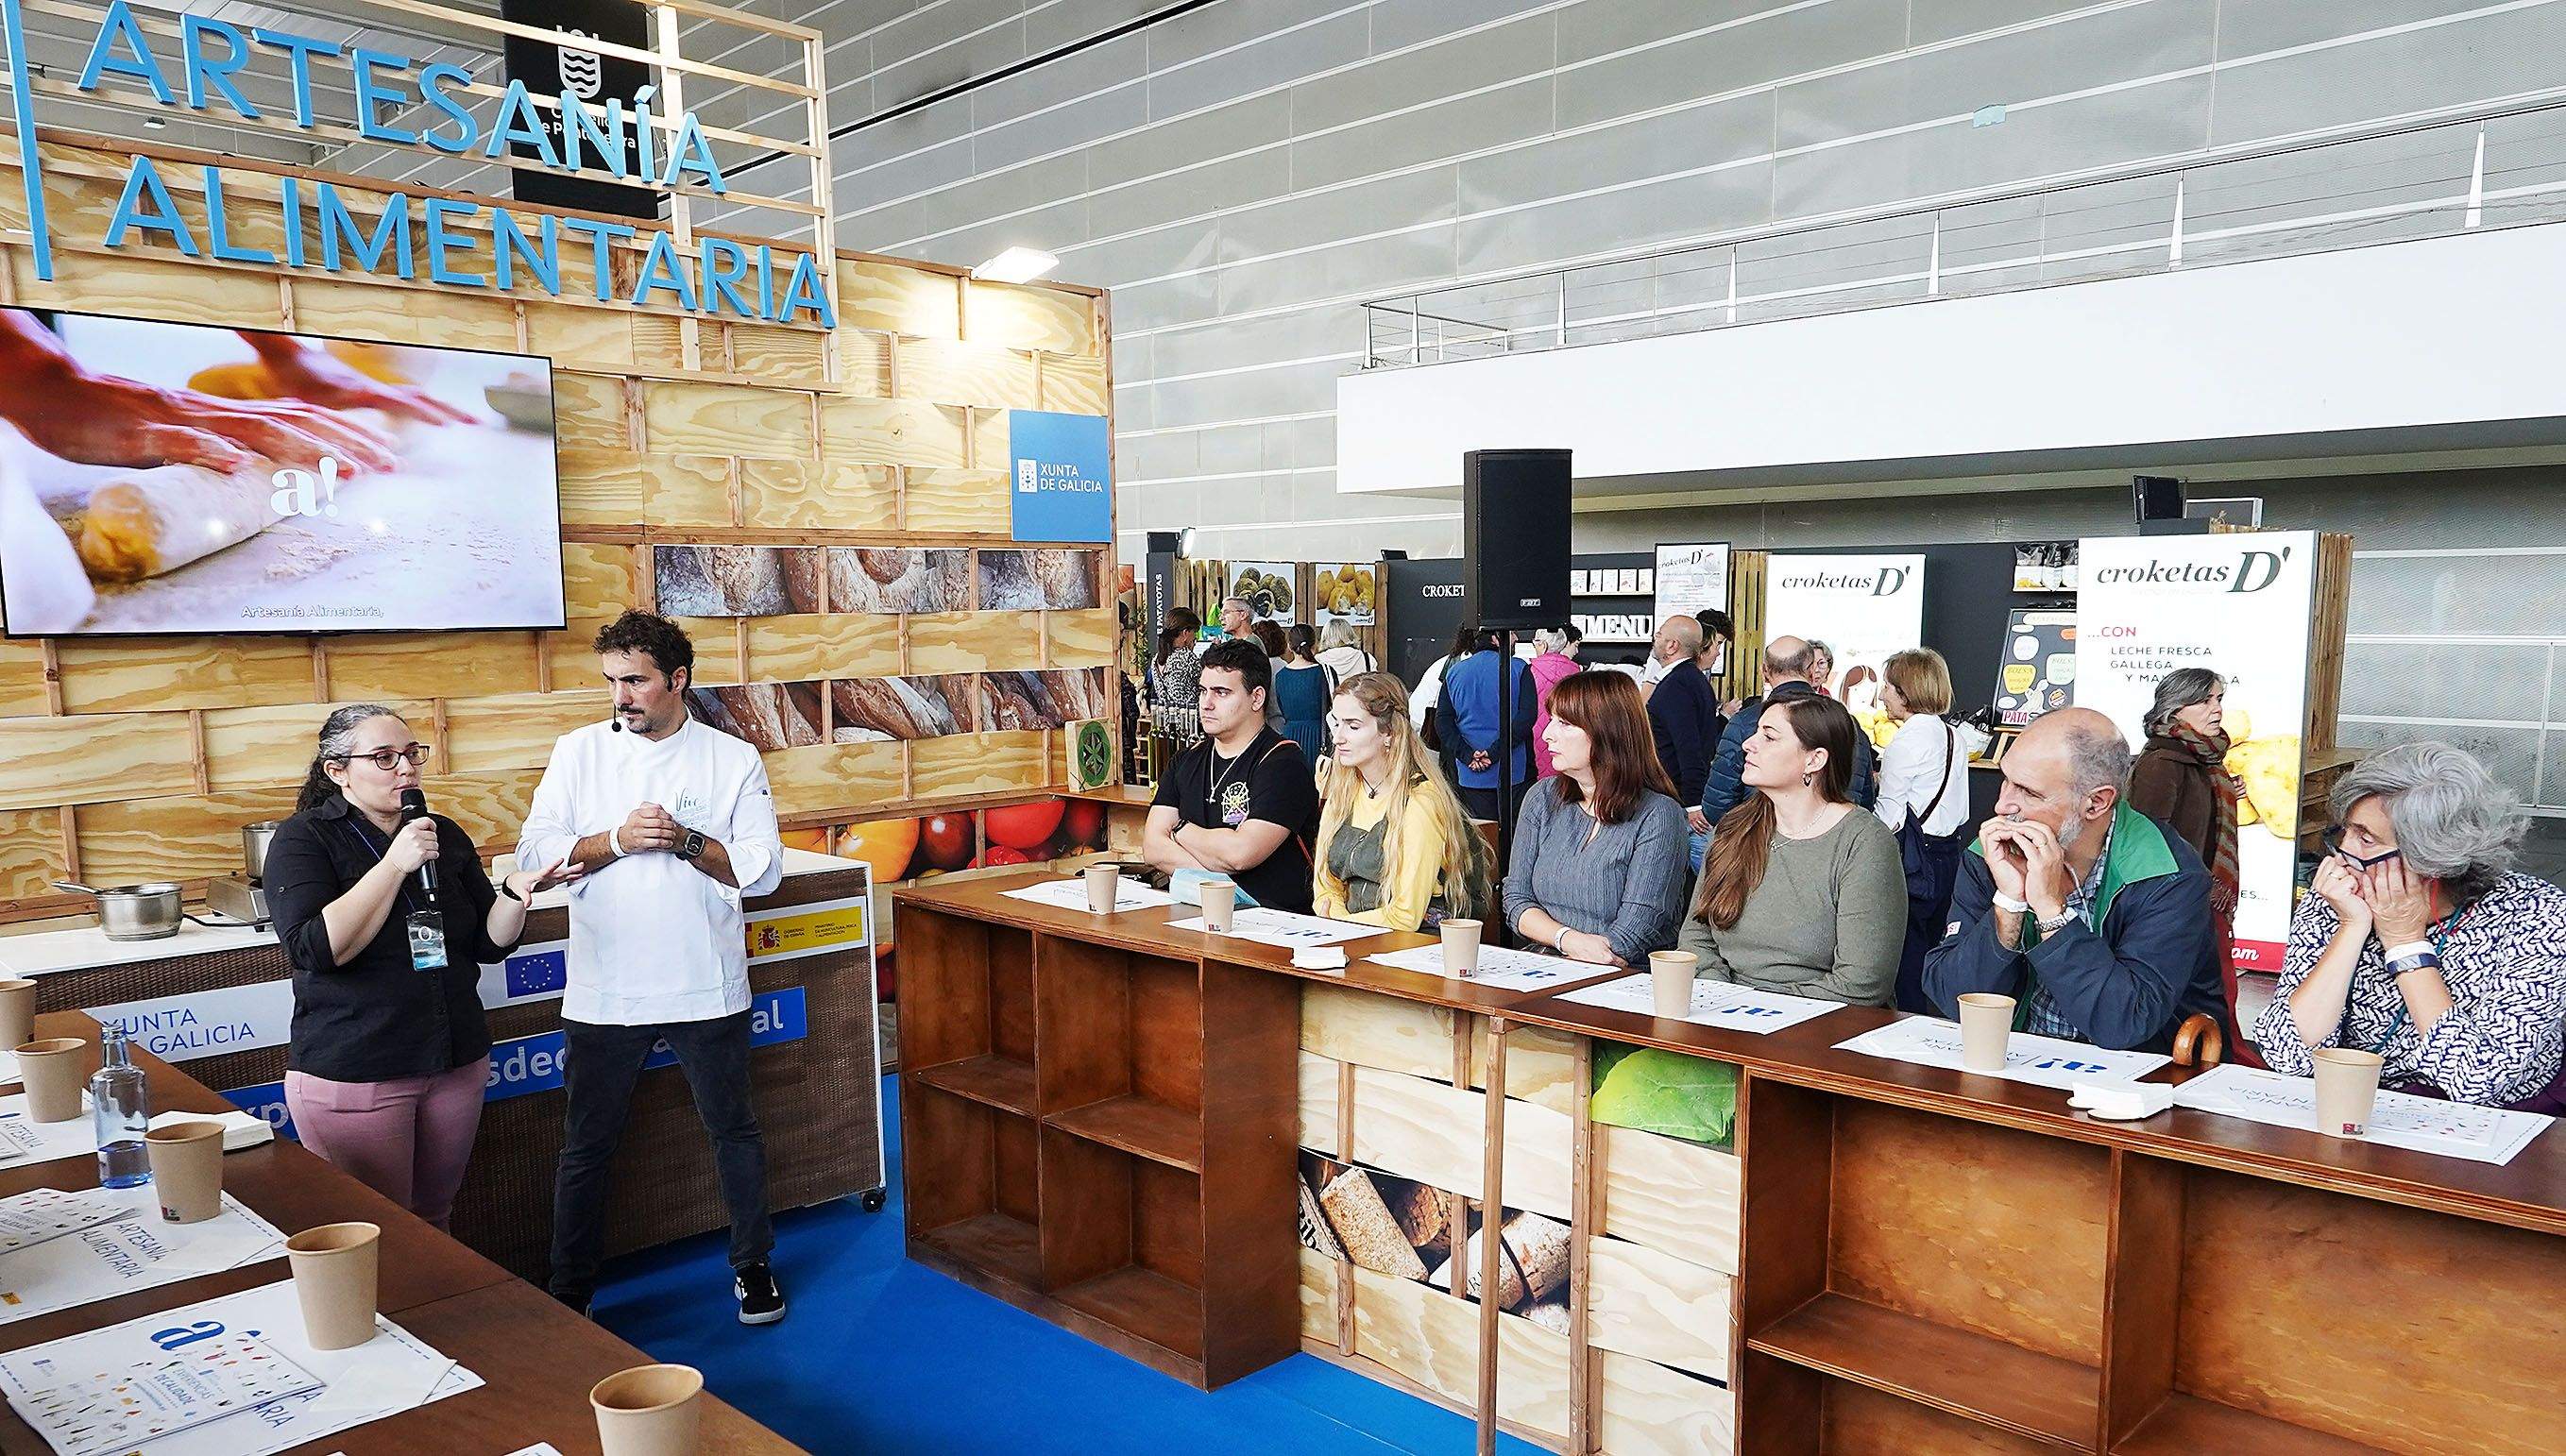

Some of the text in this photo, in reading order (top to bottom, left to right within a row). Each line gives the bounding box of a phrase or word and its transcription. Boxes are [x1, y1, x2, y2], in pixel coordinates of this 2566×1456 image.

[77, 0, 726, 195] ARTESANÍA
[104, 155, 835, 329] ALIMENTARIA
[1041, 463, 1079, 477] XUNTA
[270, 456, 340, 517] a!
[1041, 478, 1102, 492] DE GALICIA
[1782, 572, 1872, 588] croketas
[2097, 559, 2230, 584] croketas
[241, 604, 304, 618] Artesanía
[1587, 615, 1653, 636] MENU
[2111, 647, 2212, 656] LECHE FRESCA
[2110, 660, 2173, 669] GALLEGA
[149, 1022, 255, 1054] GALICIA
[76, 1230, 144, 1278] ALIMENTARIA
